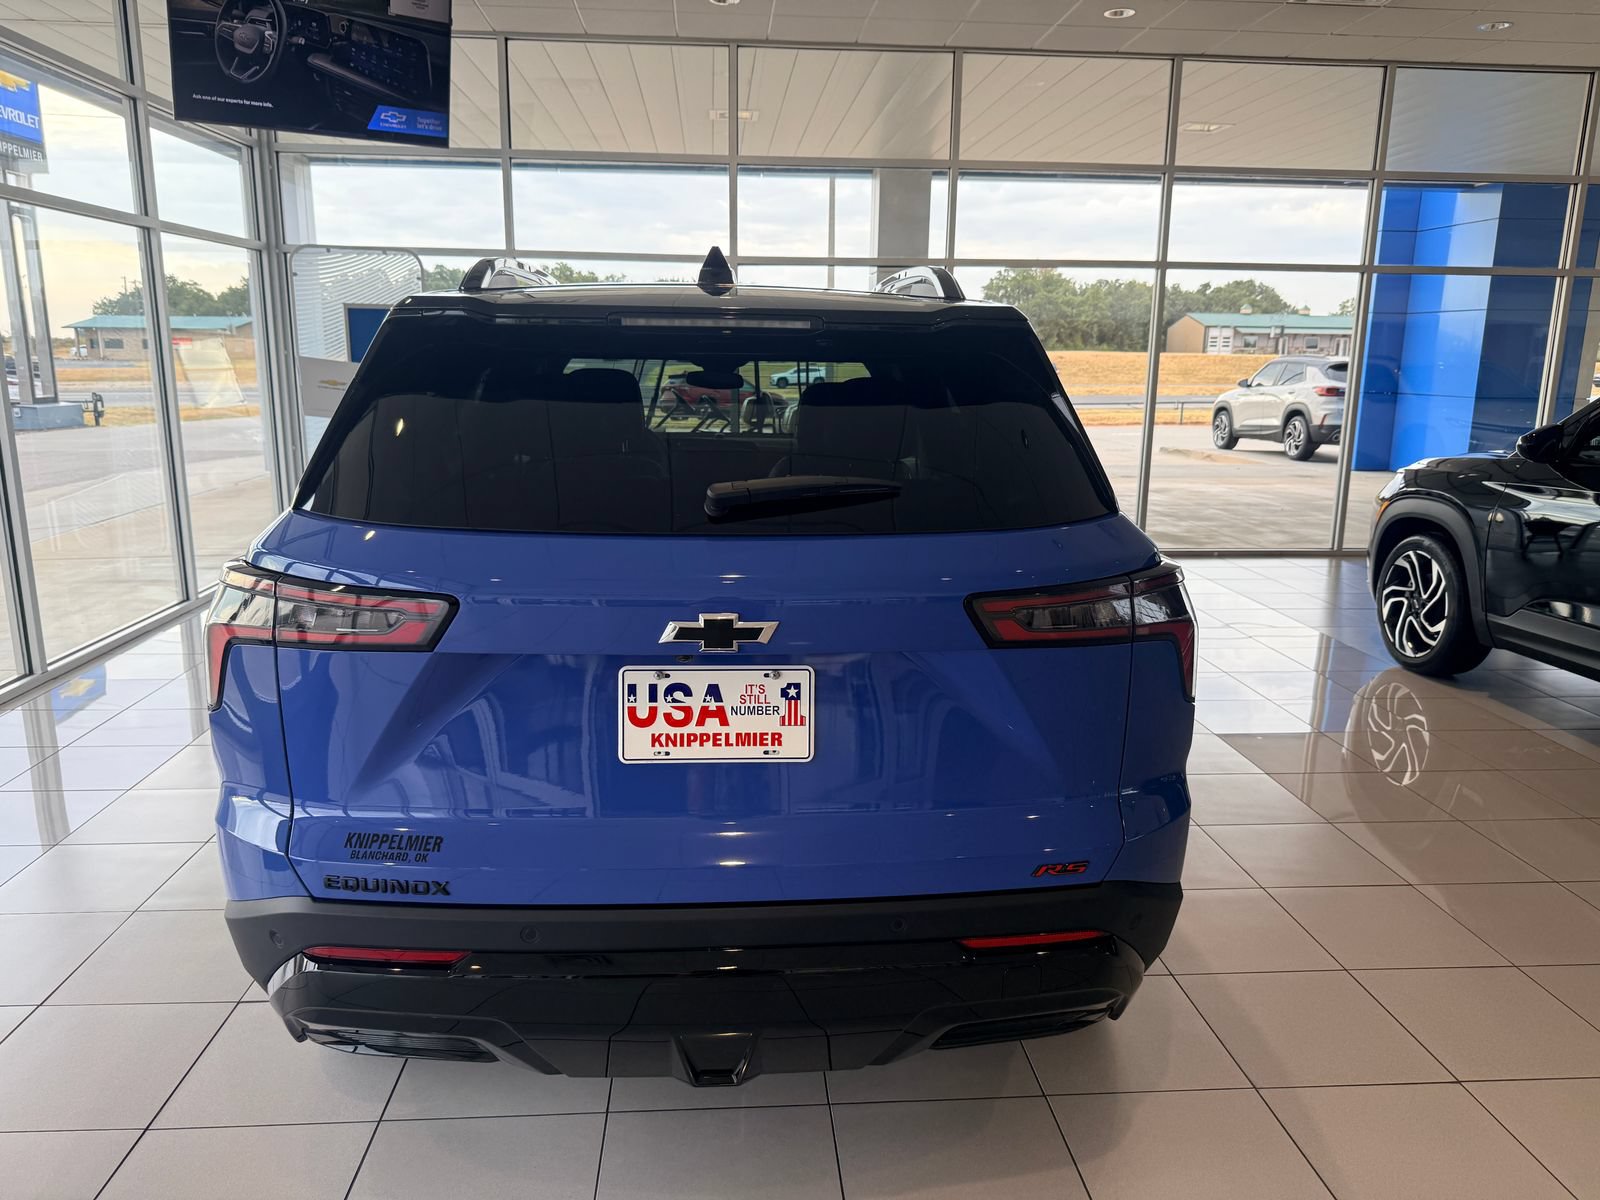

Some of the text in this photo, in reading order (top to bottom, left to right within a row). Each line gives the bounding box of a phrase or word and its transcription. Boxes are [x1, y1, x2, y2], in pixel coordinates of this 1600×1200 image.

[745, 684, 765, 694] IT'S
[627, 682, 730, 728] USA
[739, 694, 771, 705] STILL
[730, 705, 780, 716] NUMBER
[651, 732, 783, 748] KNIPPELMIER
[344, 832, 444, 853] KNIPPELMIER
[350, 850, 429, 864] BLANCHARD, OK
[1031, 860, 1089, 877] RS
[323, 874, 451, 896] EQUINOX
